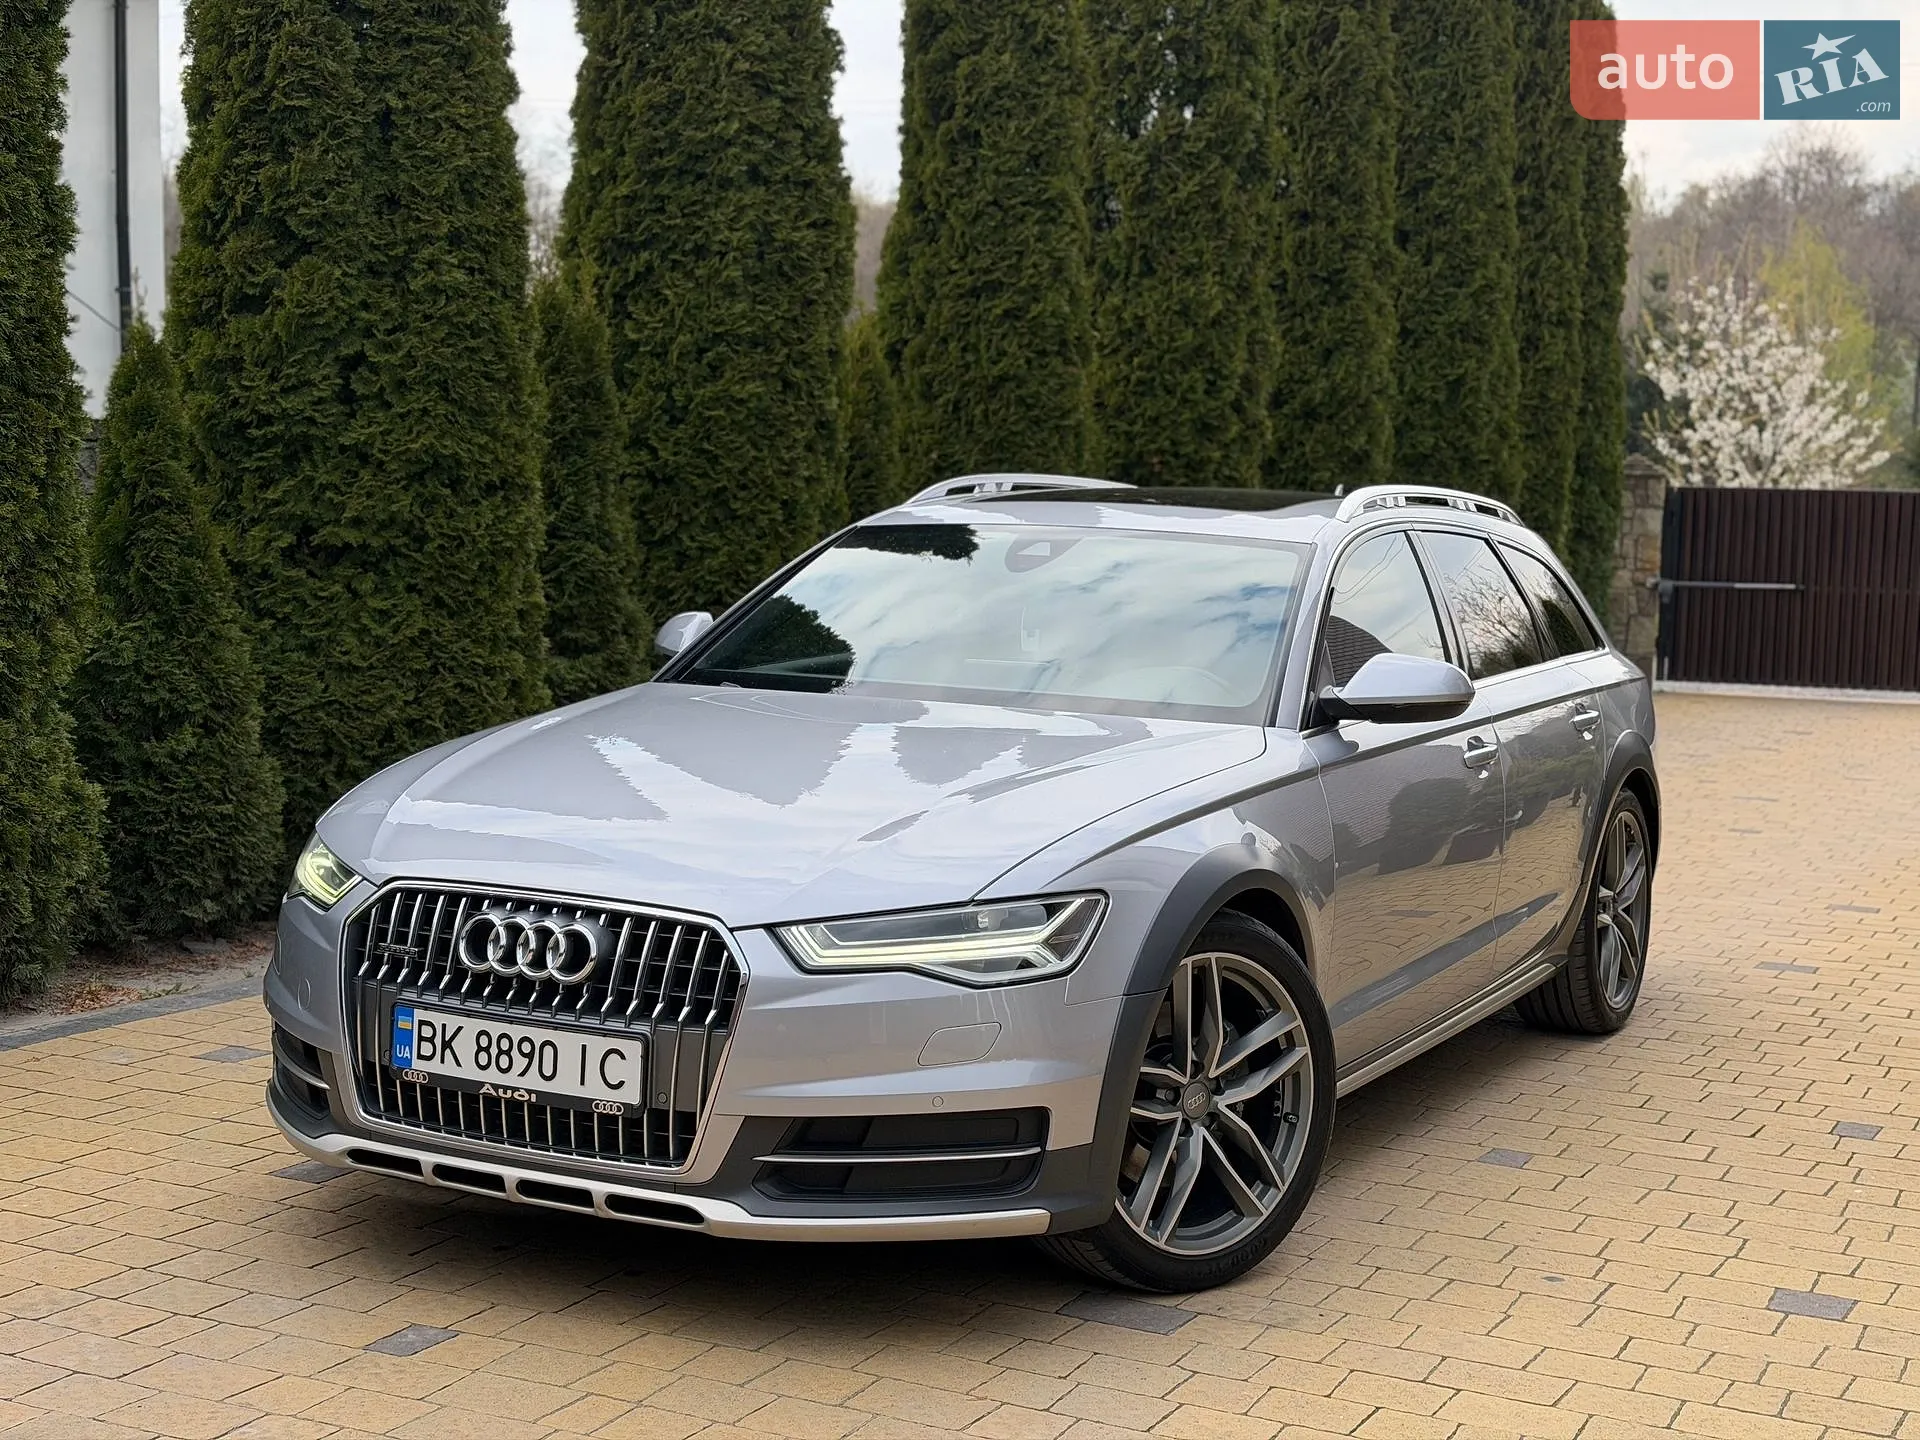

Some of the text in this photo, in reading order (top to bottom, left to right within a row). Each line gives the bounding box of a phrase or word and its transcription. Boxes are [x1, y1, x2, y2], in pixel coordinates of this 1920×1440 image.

[396, 1045, 411, 1059] UA
[416, 1019, 464, 1068] BK
[474, 1029, 558, 1082] 8890
[478, 1083, 537, 1103] Audi
